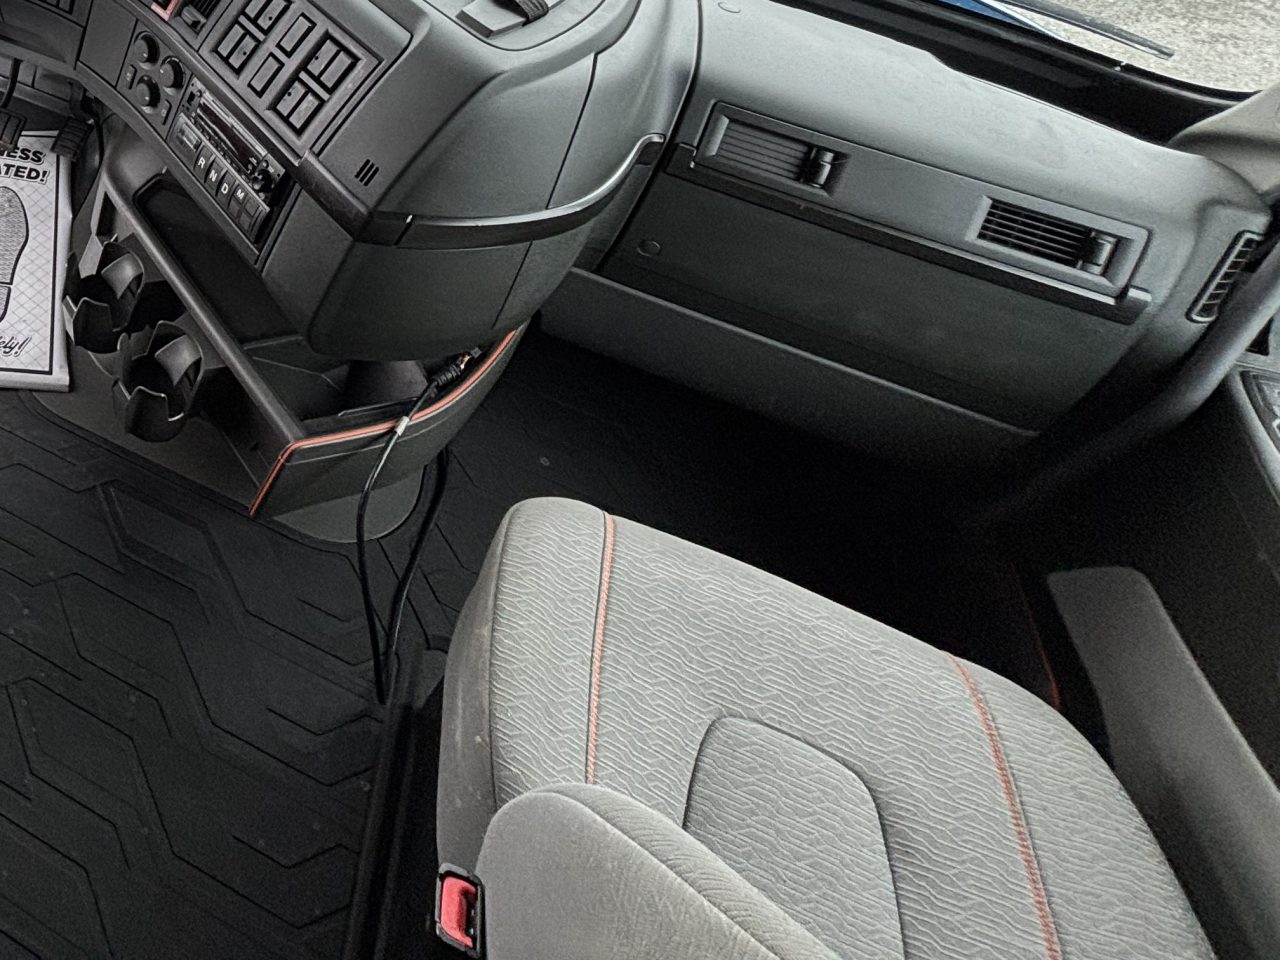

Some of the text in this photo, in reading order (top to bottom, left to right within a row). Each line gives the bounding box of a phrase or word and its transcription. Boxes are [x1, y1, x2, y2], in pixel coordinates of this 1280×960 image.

[198, 157, 245, 200] R N D M
